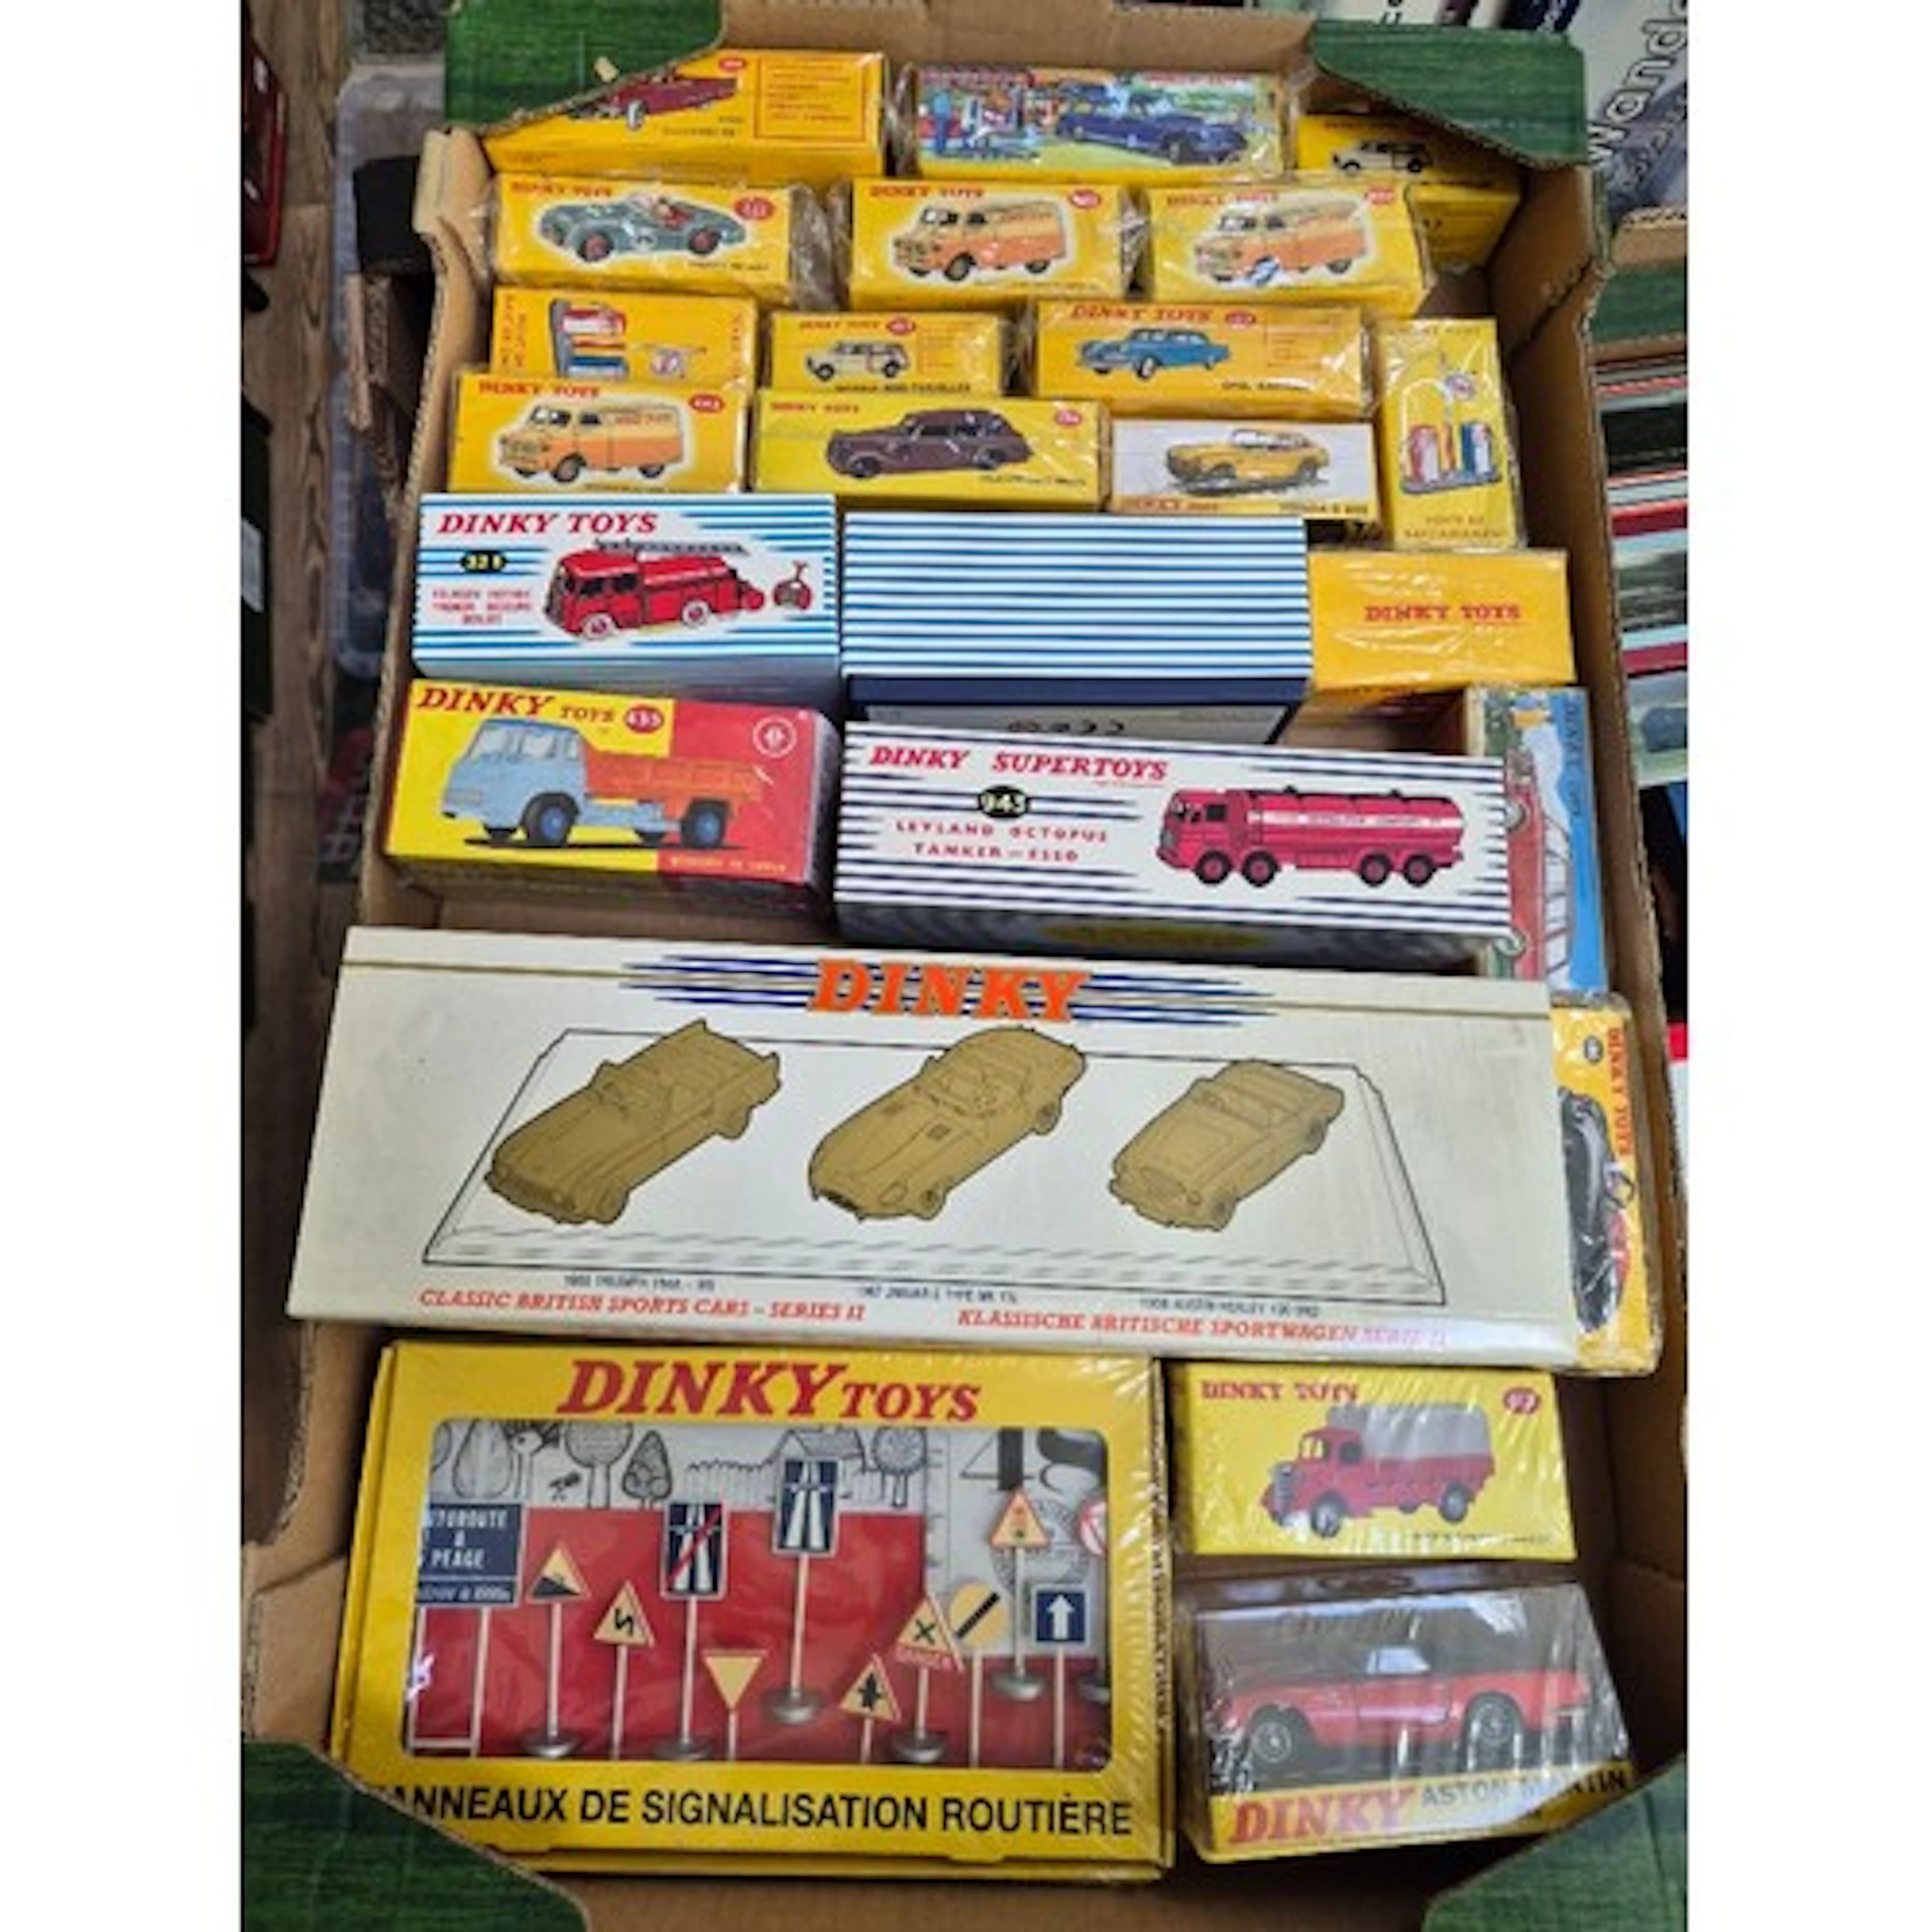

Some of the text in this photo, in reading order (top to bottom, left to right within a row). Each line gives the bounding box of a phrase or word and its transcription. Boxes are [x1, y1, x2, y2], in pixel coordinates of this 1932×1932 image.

[870, 186, 985, 199] DINKY TOYS
[1071, 304, 1147, 321] DINKY
[1156, 306, 1214, 323] TOYS
[479, 381, 600, 398] DINKY TOYS
[438, 513, 658, 533] DINKY TOYS
[1364, 603, 1522, 622] DINKY TOYS
[418, 686, 615, 723] DINKY TOYS
[869, 746, 1169, 782] DINKY SUPERTOYS
[896, 821, 1108, 843] LEYLAND OCTOPUS
[914, 842, 1002, 858] TANKER
[807, 958, 1092, 1023] DINKY
[419, 1289, 510, 1309] CLASSIC
[515, 1292, 602, 1313] BRITISH
[607, 1294, 688, 1315] SPORTS
[692, 1298, 749, 1318] CARS
[769, 1301, 840, 1321] SERIES
[843, 1304, 866, 1322] II
[957, 1308, 1084, 1330] KLASSISCHE
[1089, 1313, 1205, 1336] BRITISCHE
[1209, 1317, 1359, 1341] SPORTWAGEN
[556, 1359, 982, 1421] DINKY TOYS
[1200, 1380, 1284, 1400] DINKY
[395, 1785, 1132, 1835] NNEAUX DE SIGNALISATION ROUTIÈRE
[1228, 1786, 1413, 1845] DINKY
[1420, 1777, 1509, 1807] ASTON
